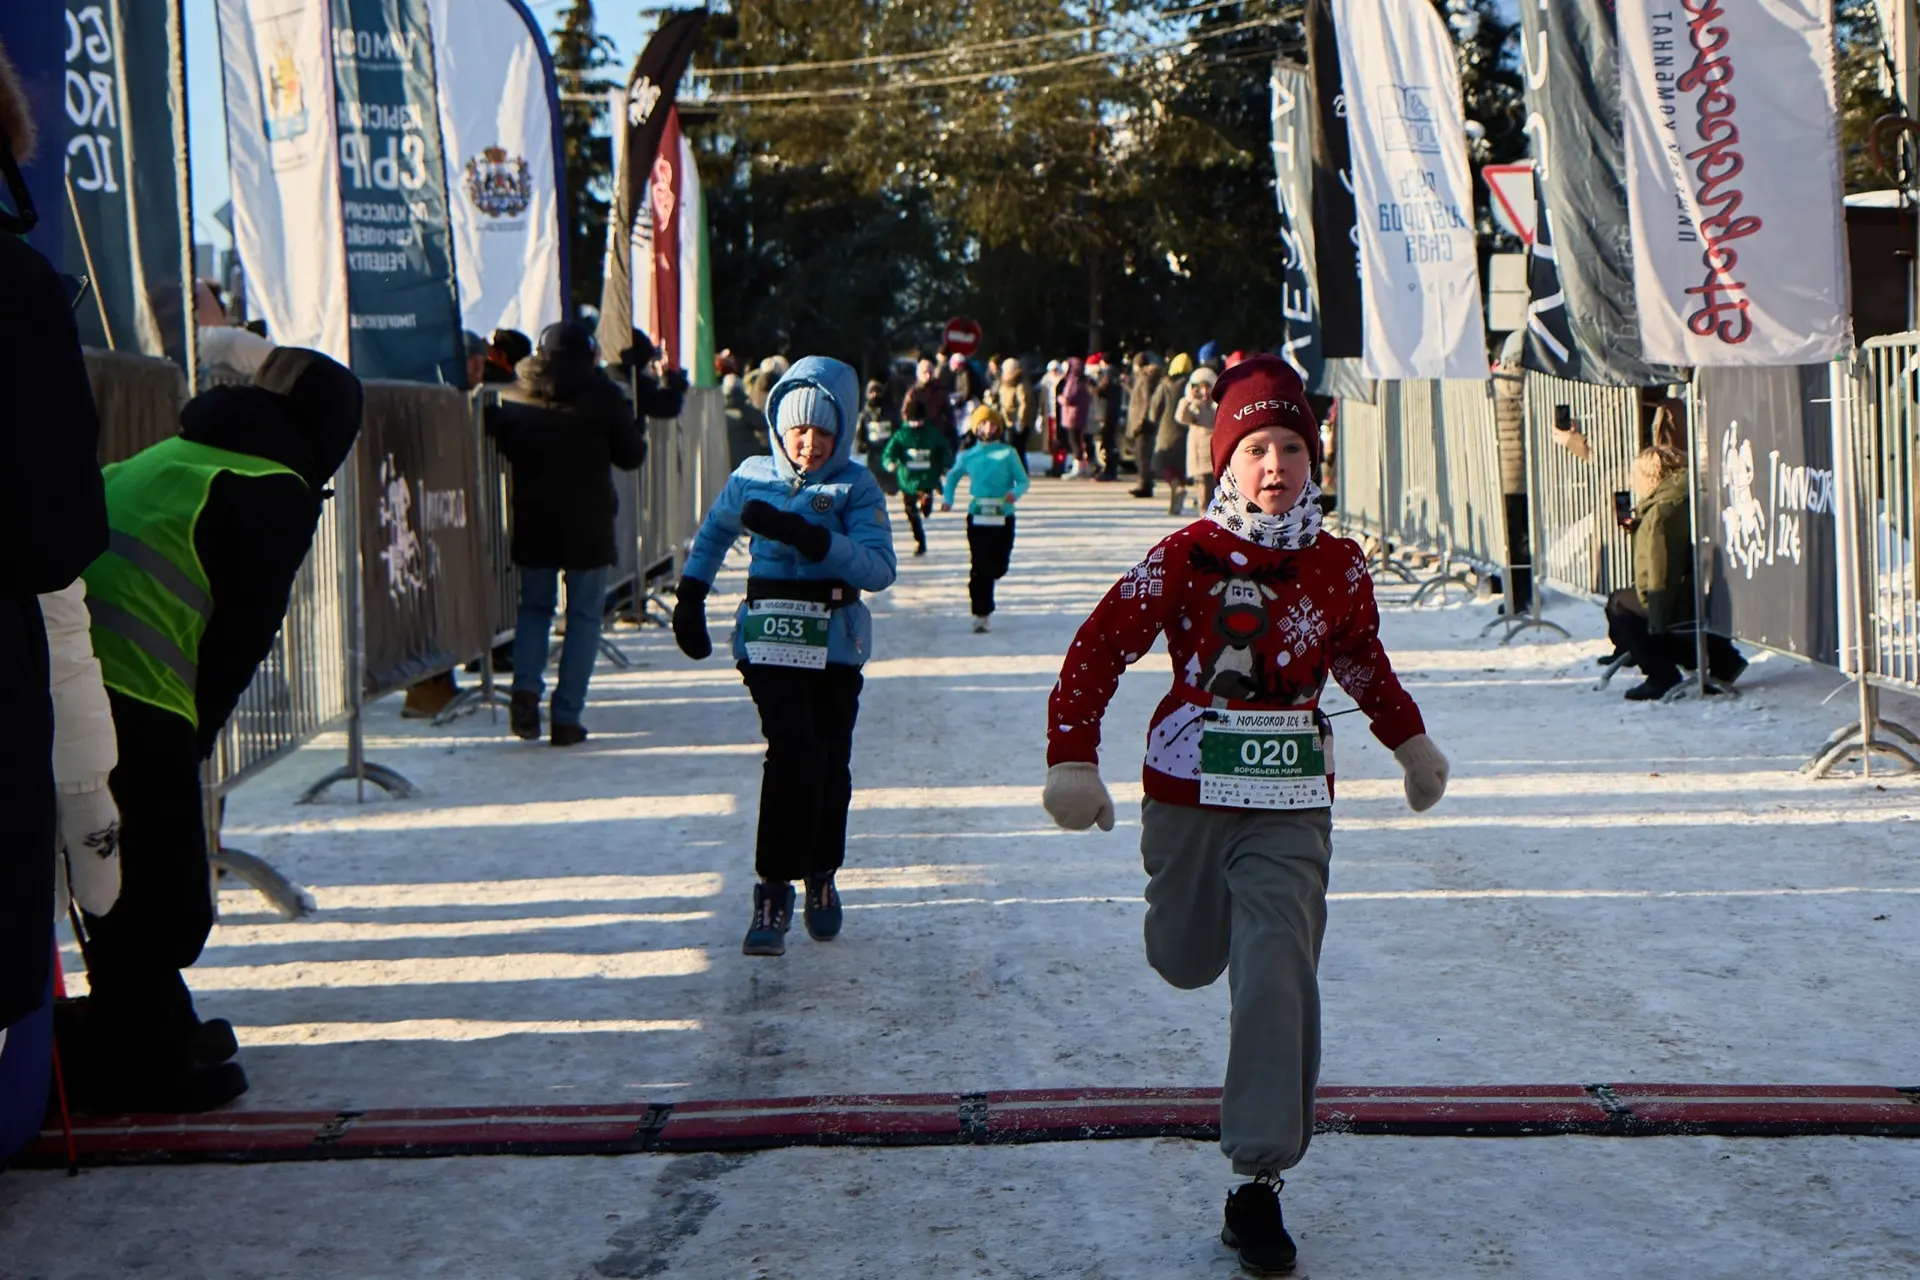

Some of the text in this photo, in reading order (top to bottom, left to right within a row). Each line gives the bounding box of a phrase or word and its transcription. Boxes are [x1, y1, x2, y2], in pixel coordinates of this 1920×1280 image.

[1233, 400, 1301, 421] VERSTA
[763, 616, 804, 638] 053
[1236, 715, 1299, 727] NOVGOROD ICE
[1240, 739, 1299, 766] 020
[1234, 766, 1280, 775] ВОРОБЬЕВА
